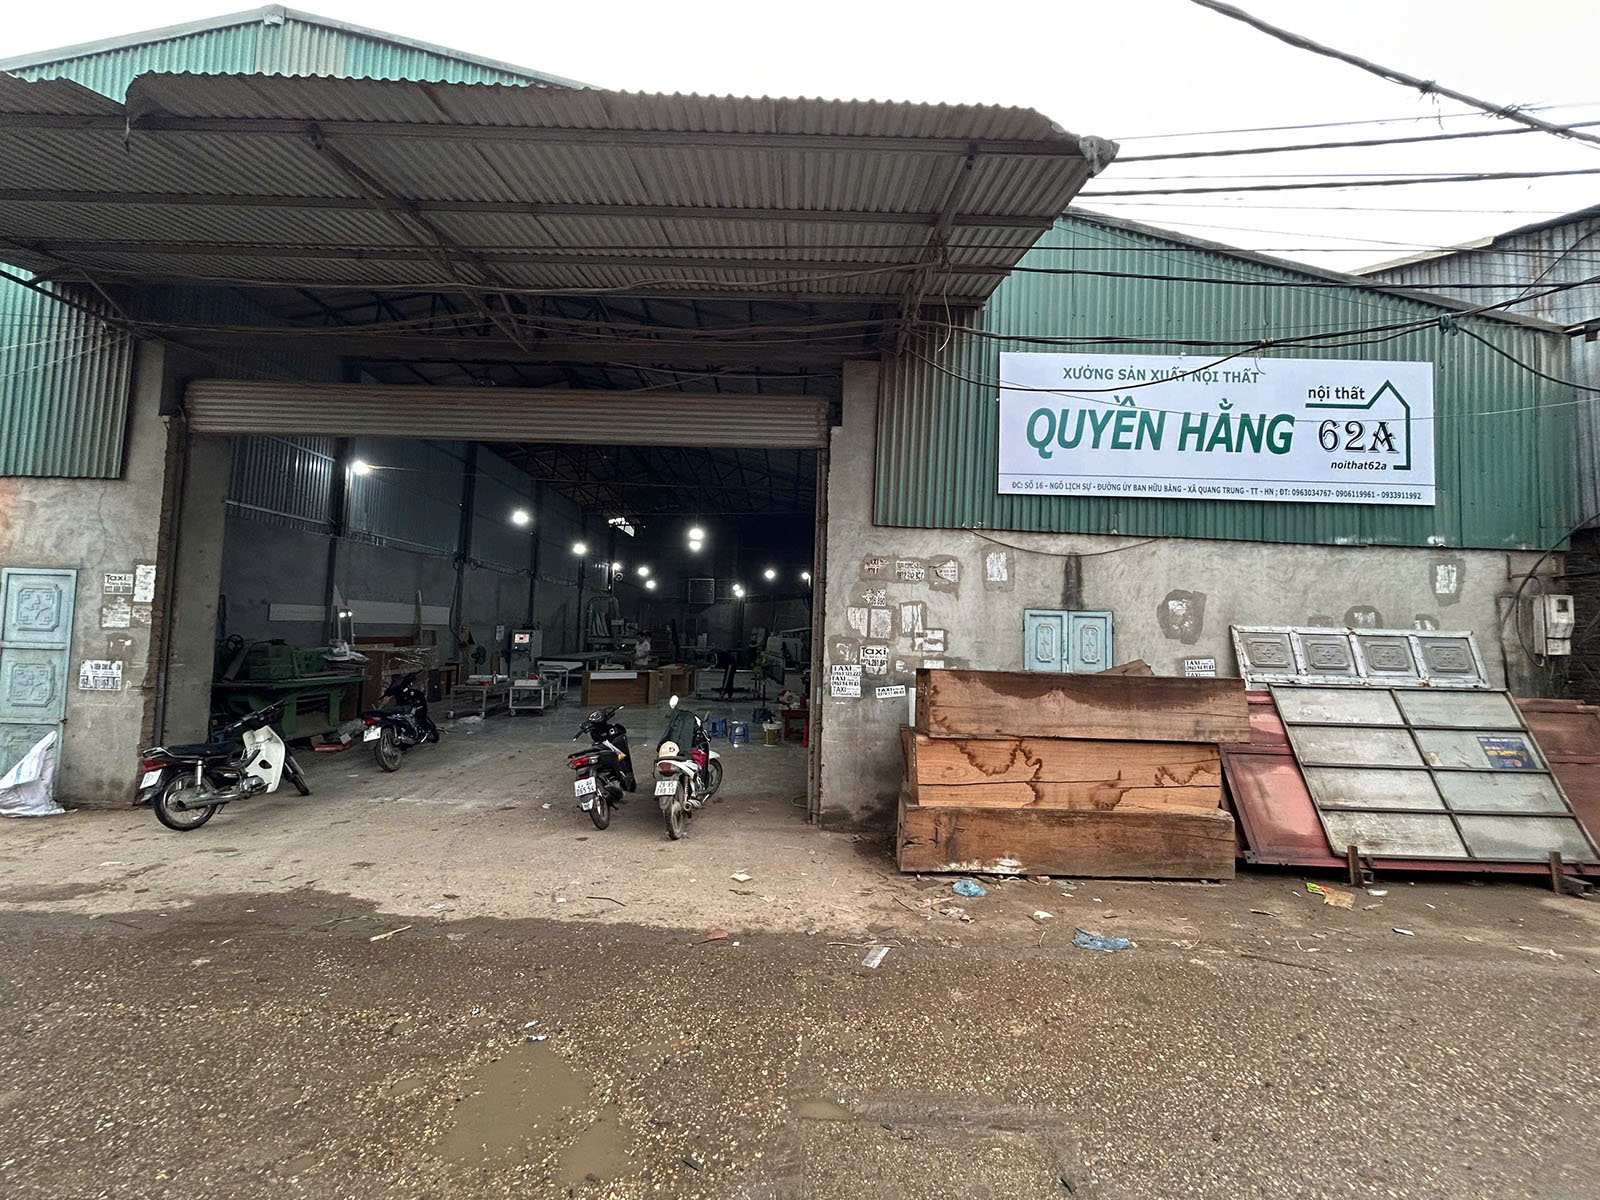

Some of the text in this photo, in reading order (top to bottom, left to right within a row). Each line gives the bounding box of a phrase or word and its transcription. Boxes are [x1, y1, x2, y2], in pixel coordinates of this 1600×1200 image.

[1063, 364, 1259, 385] XƯỞNG SẢN XUẤT NỘI THẤT
[1308, 385, 1365, 402] nội thất
[1026, 395, 1295, 459] QUYỀN HẰNG
[1318, 419, 1400, 454] 62A
[1330, 460, 1387, 470] noithat62a
[1036, 481, 1044, 489] 16
[1065, 482, 1081, 491] LỊCH
[1097, 481, 1121, 491] ĐƯỜNG
[1133, 484, 1147, 492] BAN
[1198, 486, 1221, 494] QUANG
[1222, 486, 1244, 494] TRUNG
[1250, 487, 1259, 495] TT
[861, 647, 886, 657] Taxi
